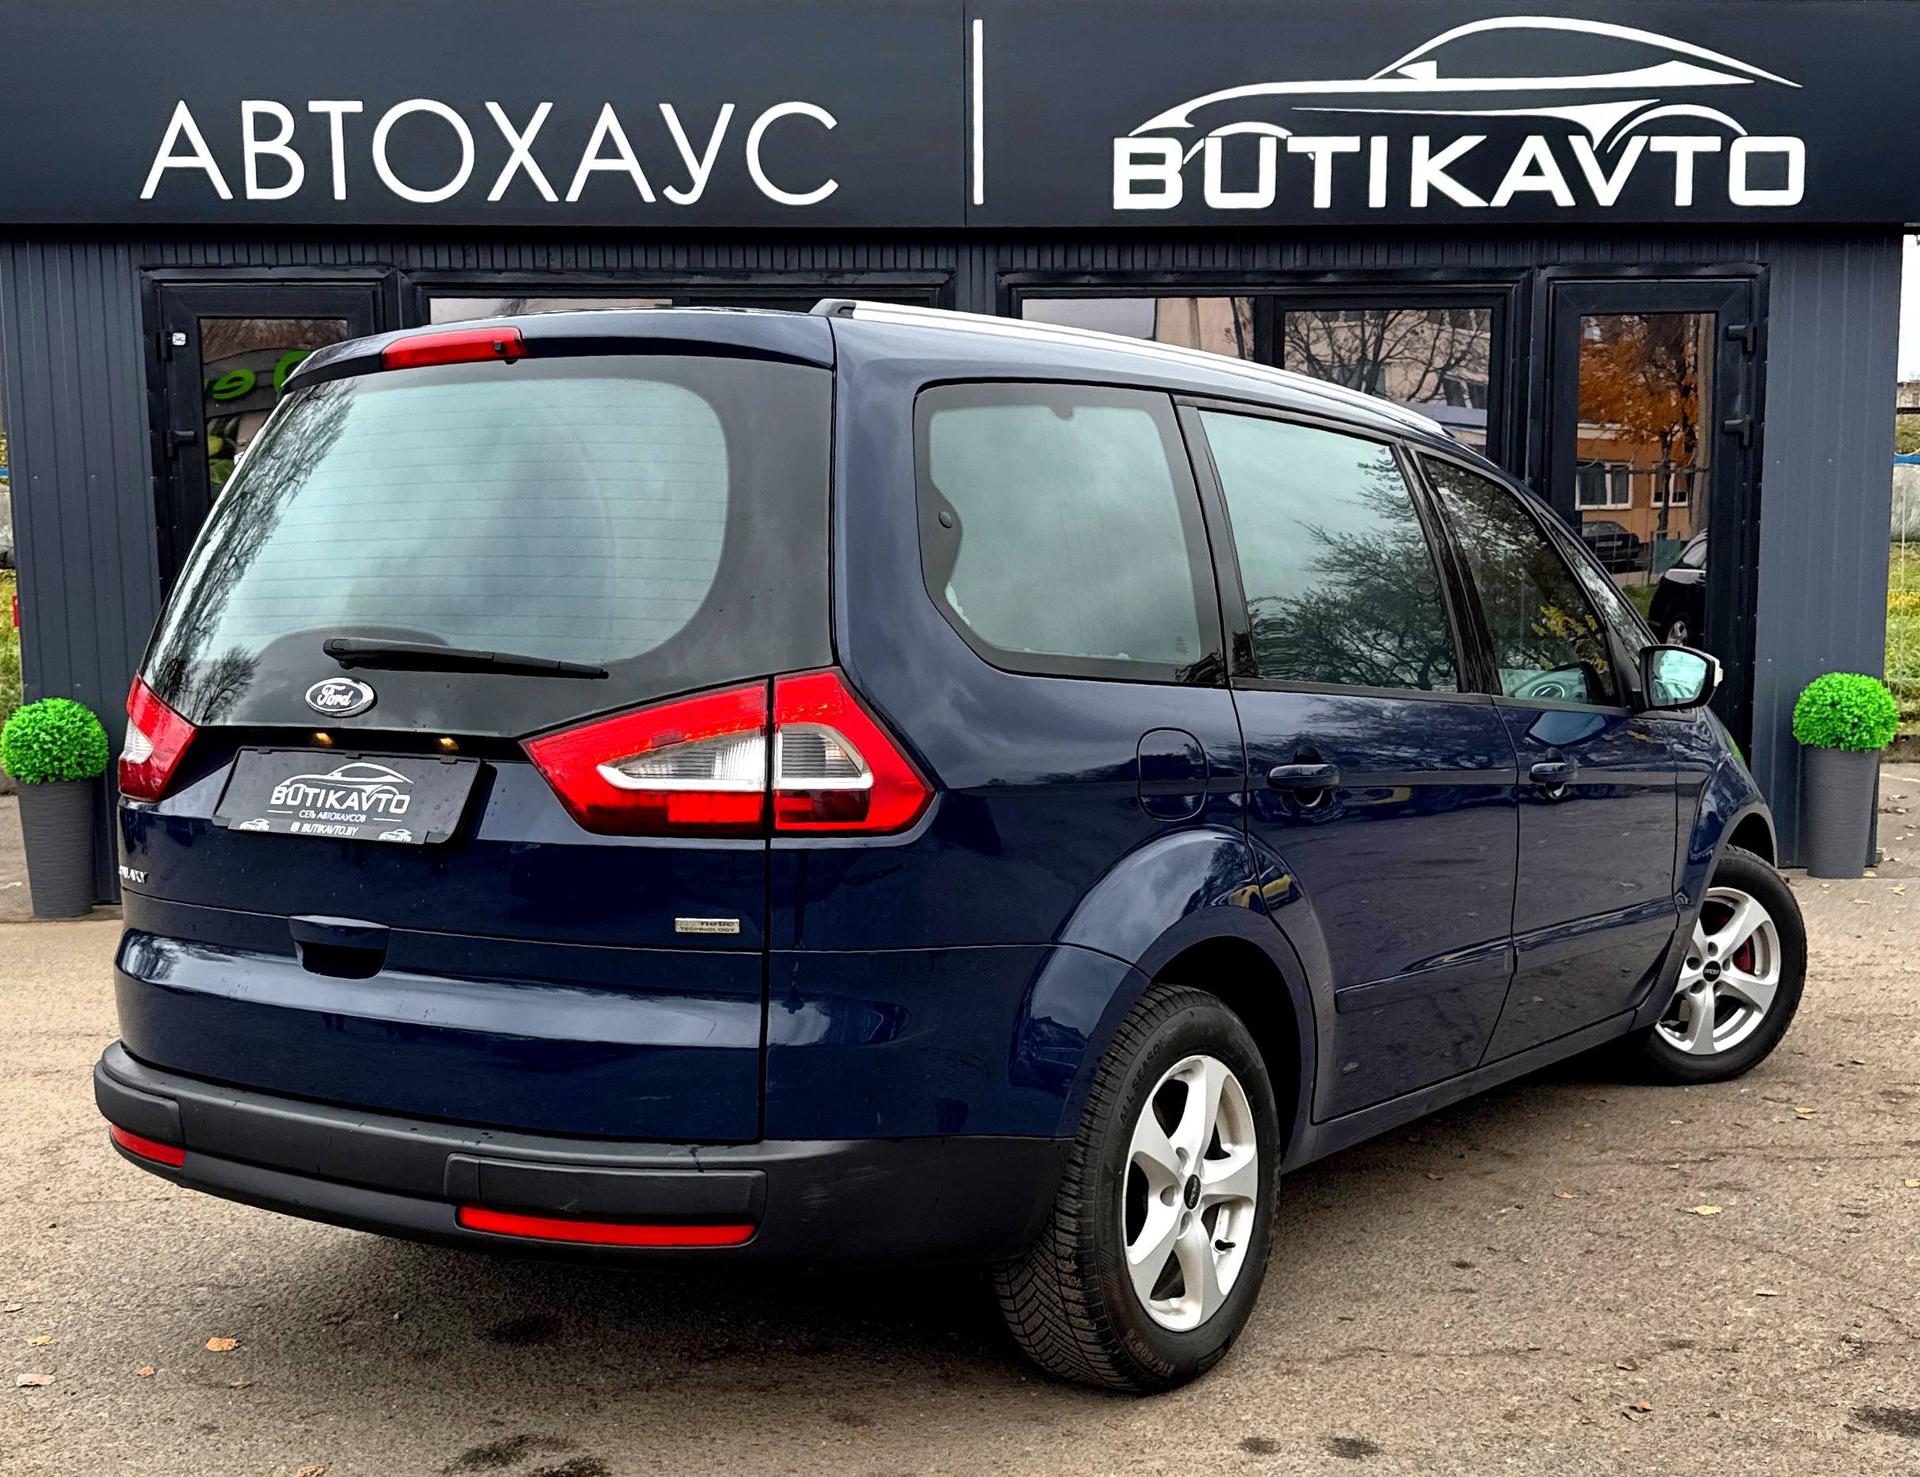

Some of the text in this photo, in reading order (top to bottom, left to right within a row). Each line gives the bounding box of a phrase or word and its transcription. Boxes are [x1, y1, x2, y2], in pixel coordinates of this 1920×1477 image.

[139, 98, 839, 206] АВТОХАУС
[1112, 134, 1807, 210] BUTIKAVTO
[316, 684, 355, 706] Ford
[270, 785, 411, 815] BUTIKAVTO
